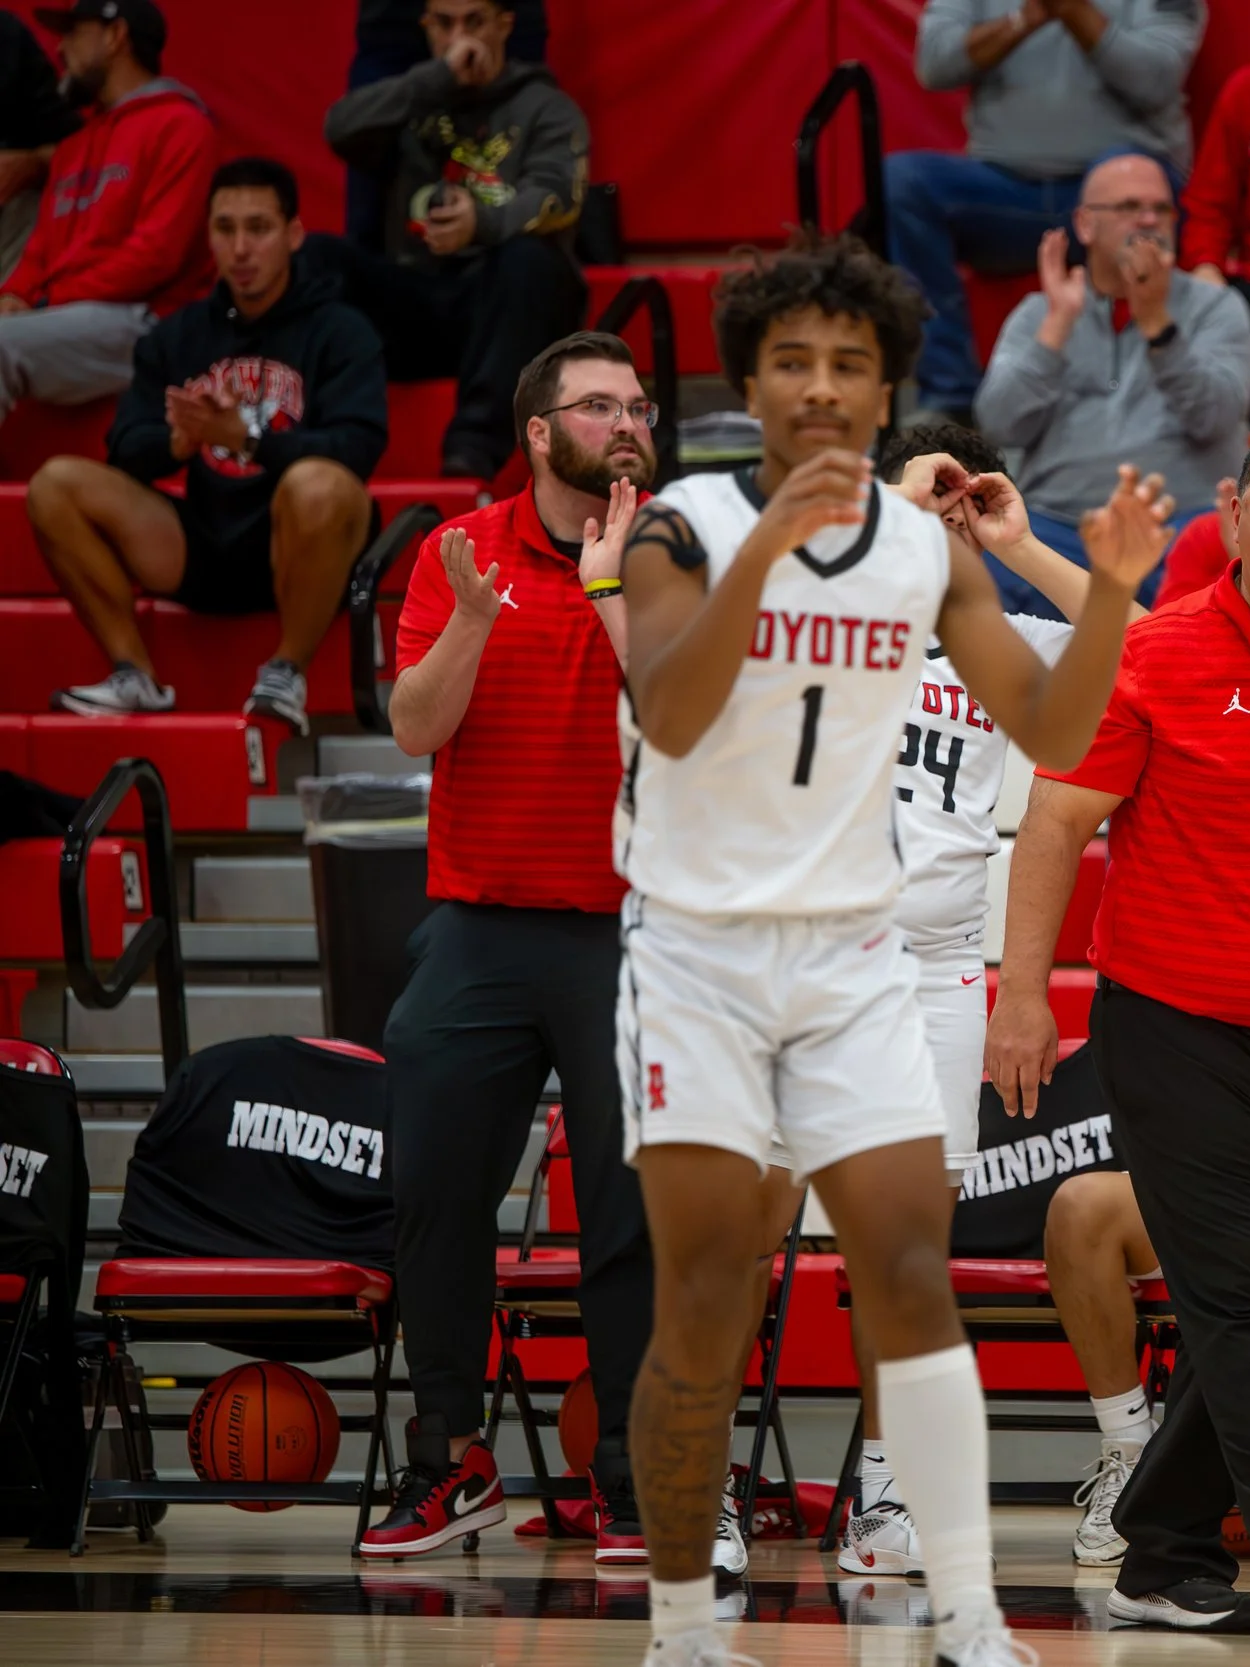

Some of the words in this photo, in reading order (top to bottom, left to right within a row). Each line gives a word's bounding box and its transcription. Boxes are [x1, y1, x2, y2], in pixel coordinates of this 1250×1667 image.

[748, 610, 910, 671] OYOTES
[793, 685, 824, 786] 1
[227, 1100, 384, 1180] MINDSET
[958, 1113, 1115, 1202] MINDSET
[227, 1394, 248, 1480] VOLUTION
